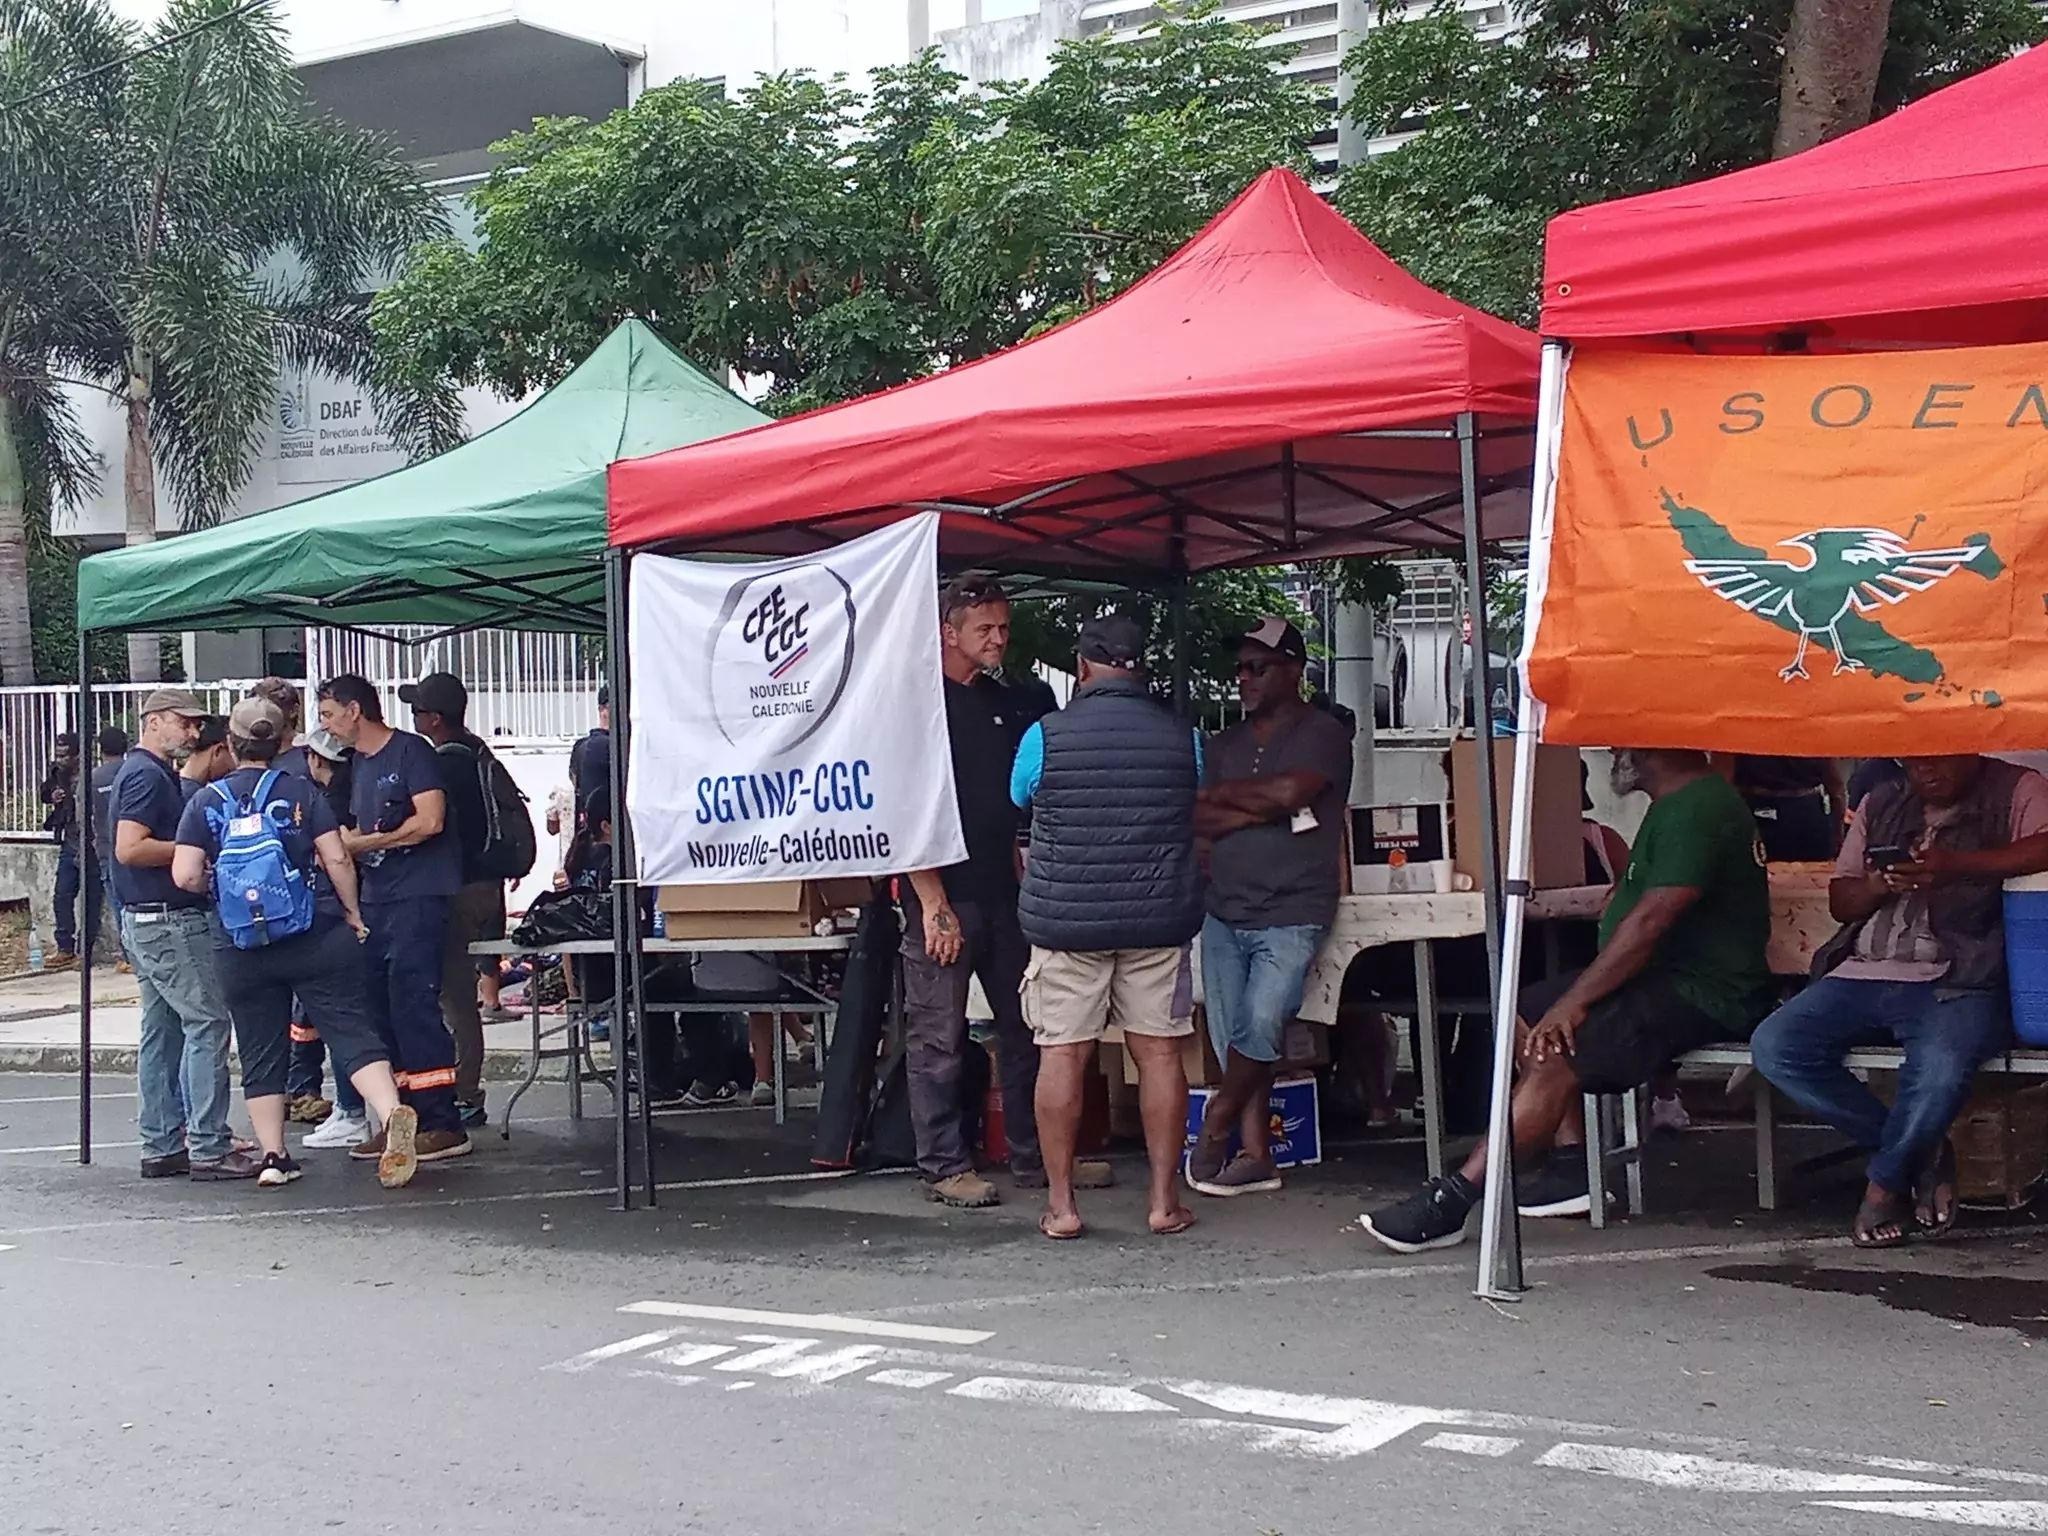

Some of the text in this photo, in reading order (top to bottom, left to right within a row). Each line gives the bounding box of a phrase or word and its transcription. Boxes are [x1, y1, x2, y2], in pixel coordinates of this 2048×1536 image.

[320, 400, 362, 420] DBAF
[320, 428, 359, 440] Direction
[361, 425, 373, 436] du
[319, 445, 335, 457] des
[336, 443, 370, 455] Affaires
[743, 584, 786, 643] CFE
[765, 602, 809, 662] CGC
[749, 680, 810, 699] NOUVELLE
[752, 699, 815, 718] CALEDONIE
[696, 760, 874, 825] SGTINC-CGC
[687, 824, 891, 869] Nouvelle-Calédonie
